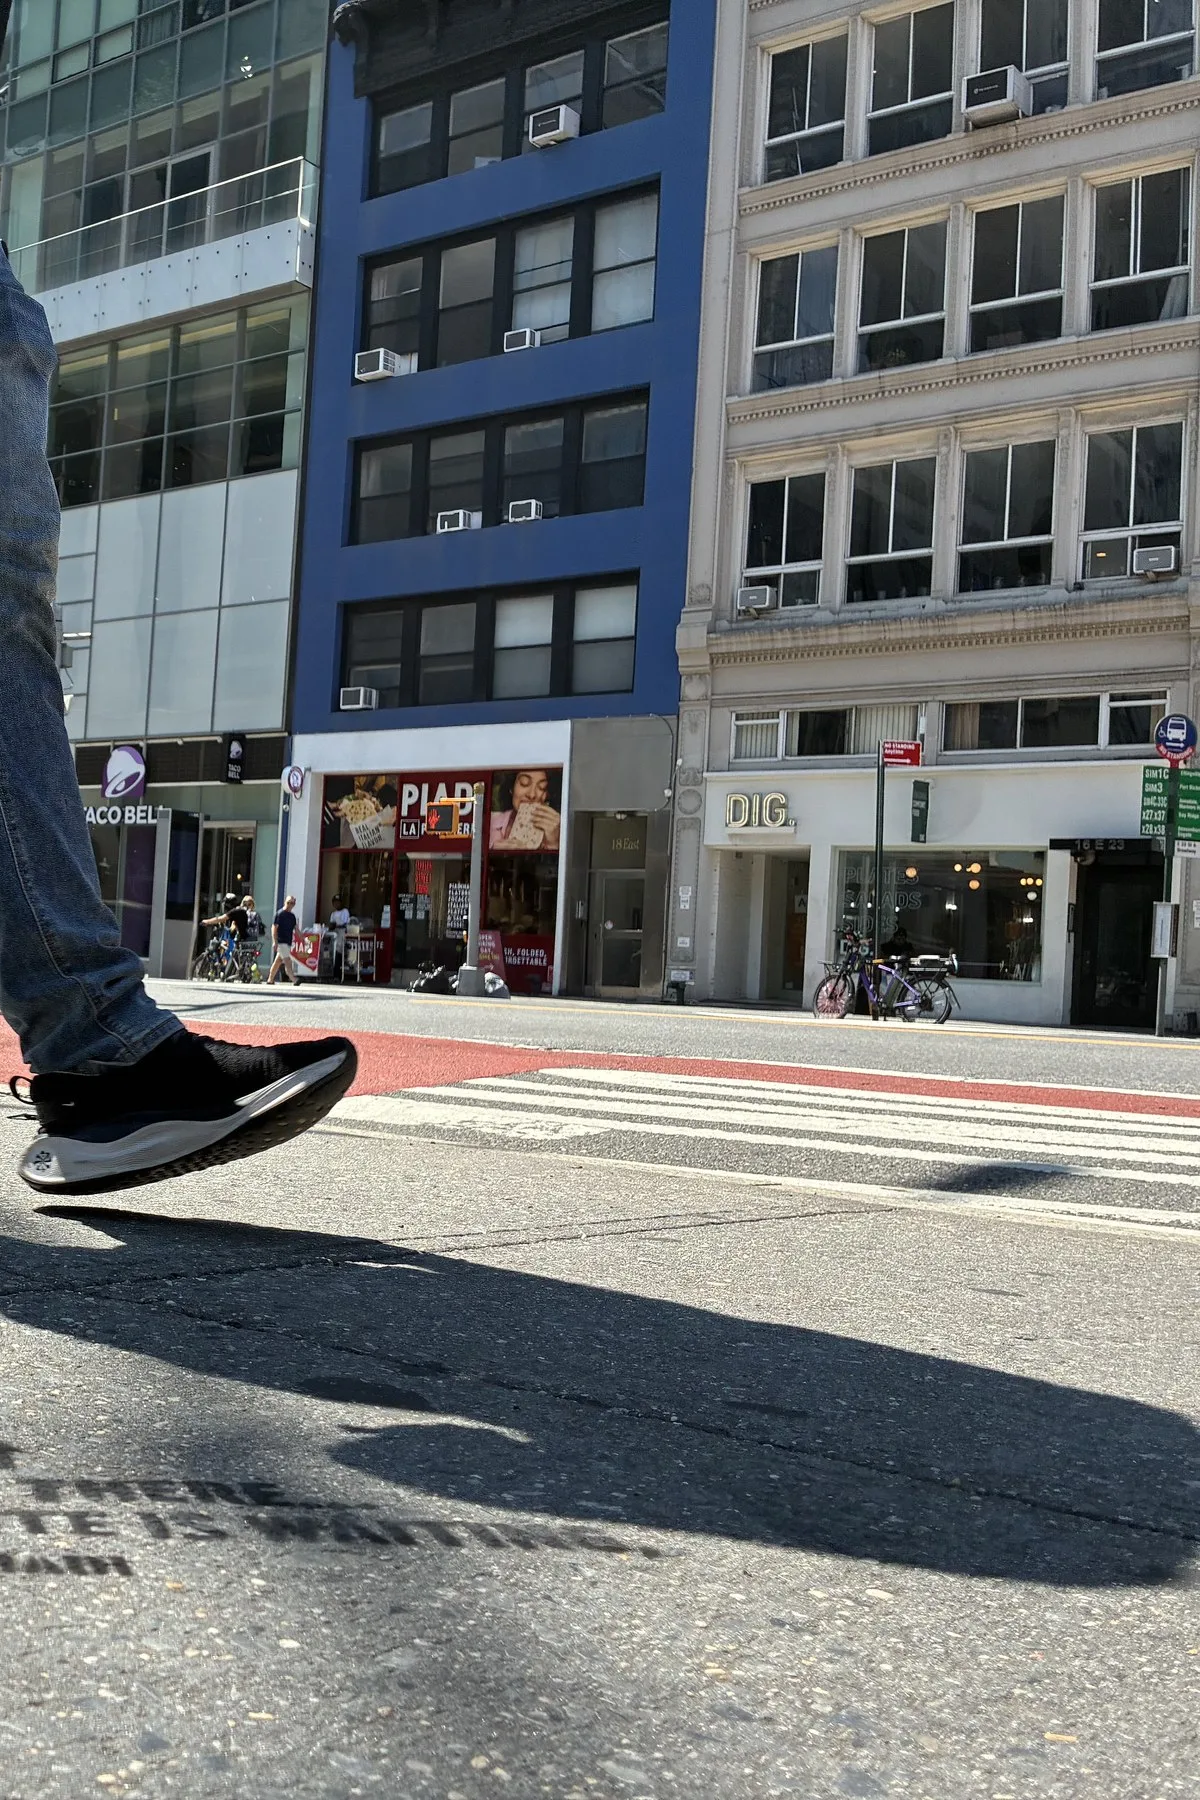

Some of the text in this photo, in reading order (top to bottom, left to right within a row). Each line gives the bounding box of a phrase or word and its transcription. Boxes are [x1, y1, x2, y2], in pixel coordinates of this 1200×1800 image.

[228, 763, 242, 773] TACO
[228, 770, 241, 779] BELL
[401, 782, 474, 817] PIAD
[83, 804, 160, 825] ACO BEL
[726, 793, 797, 828] DIG.
[402, 822, 417, 836] LA
[612, 837, 641, 850] 18 East
[1074, 840, 1126, 850] 16 E 23
[143, 1510, 231, 1541] IS
